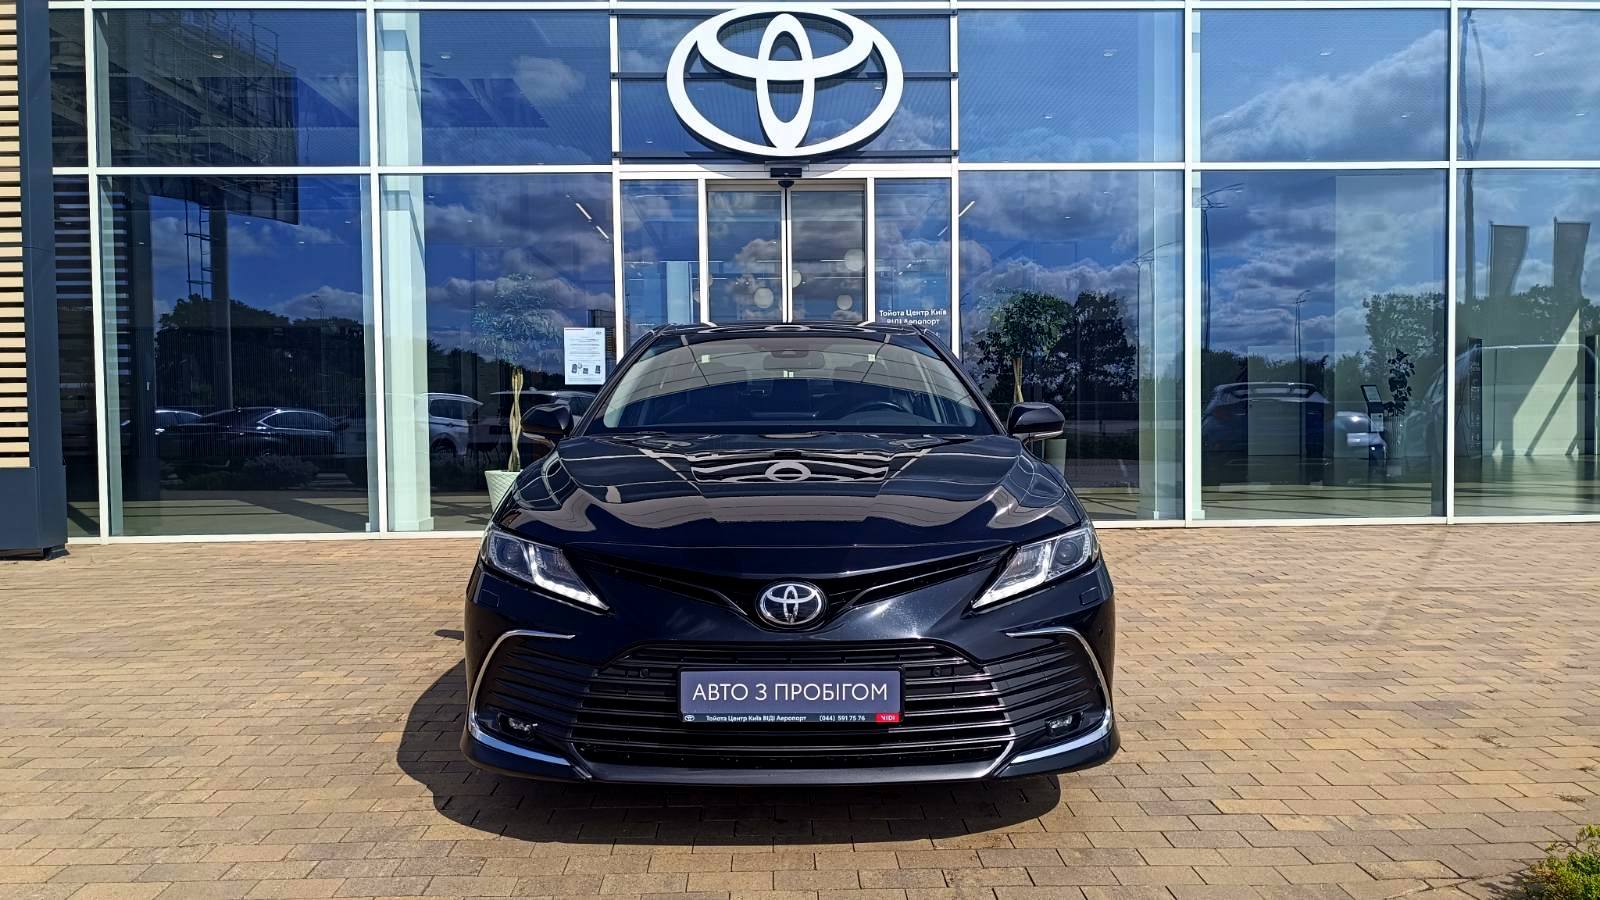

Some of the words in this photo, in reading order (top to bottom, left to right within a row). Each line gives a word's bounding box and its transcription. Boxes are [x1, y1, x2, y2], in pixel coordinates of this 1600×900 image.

[879, 309, 905, 317] Тойота
[906, 309, 930, 317] Центр
[692, 683, 749, 701] АВТО
[775, 683, 888, 701] ПРОБІГОМ
